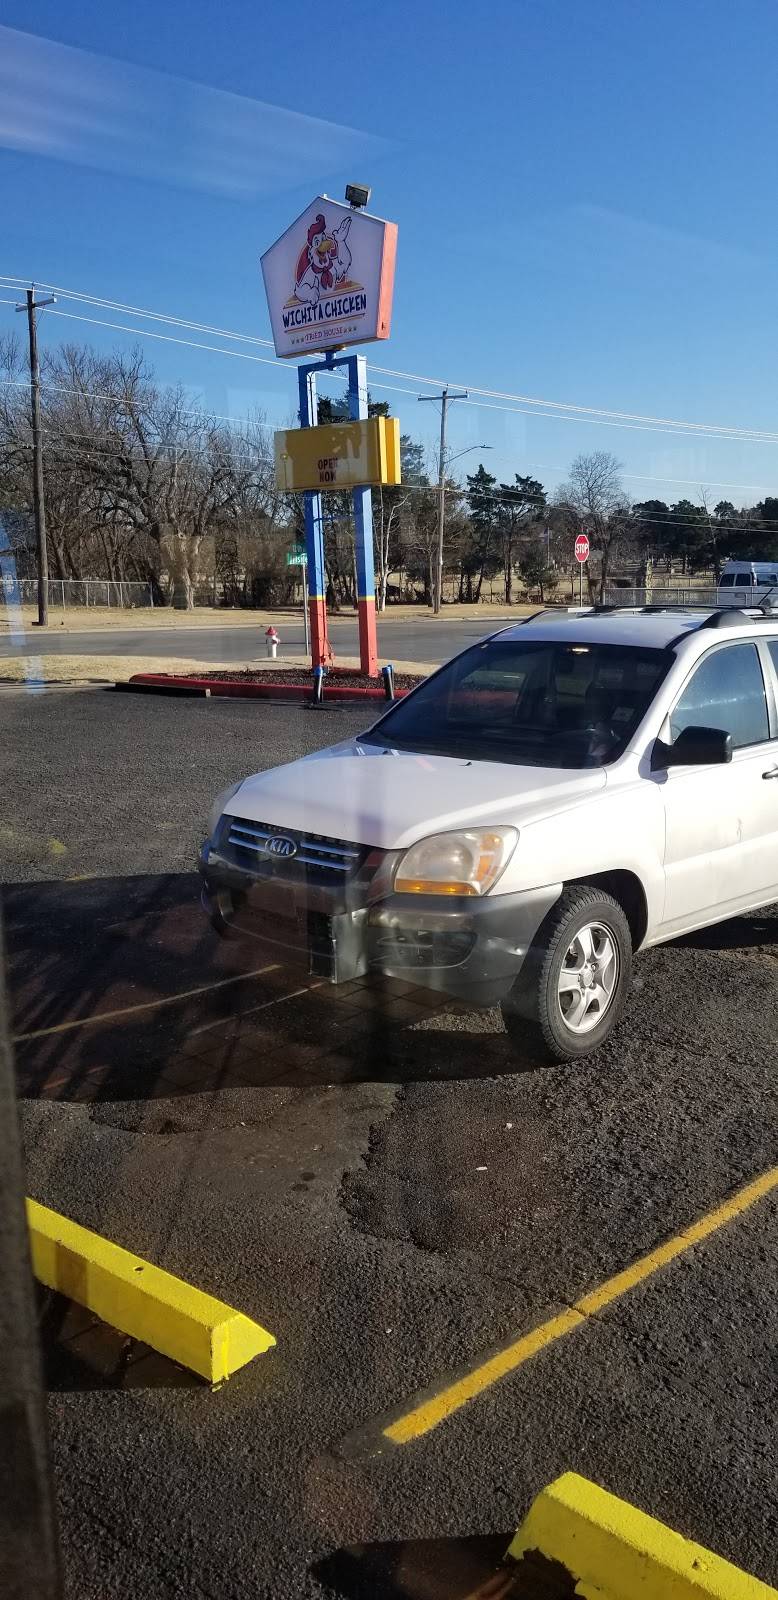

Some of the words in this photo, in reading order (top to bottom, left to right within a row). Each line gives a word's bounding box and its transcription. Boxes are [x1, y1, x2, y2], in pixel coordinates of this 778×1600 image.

[282, 305, 324, 328] WICHITA
[324, 294, 367, 318] CHICKEN
[576, 543, 589, 554] STOP
[270, 839, 290, 855] KIA
